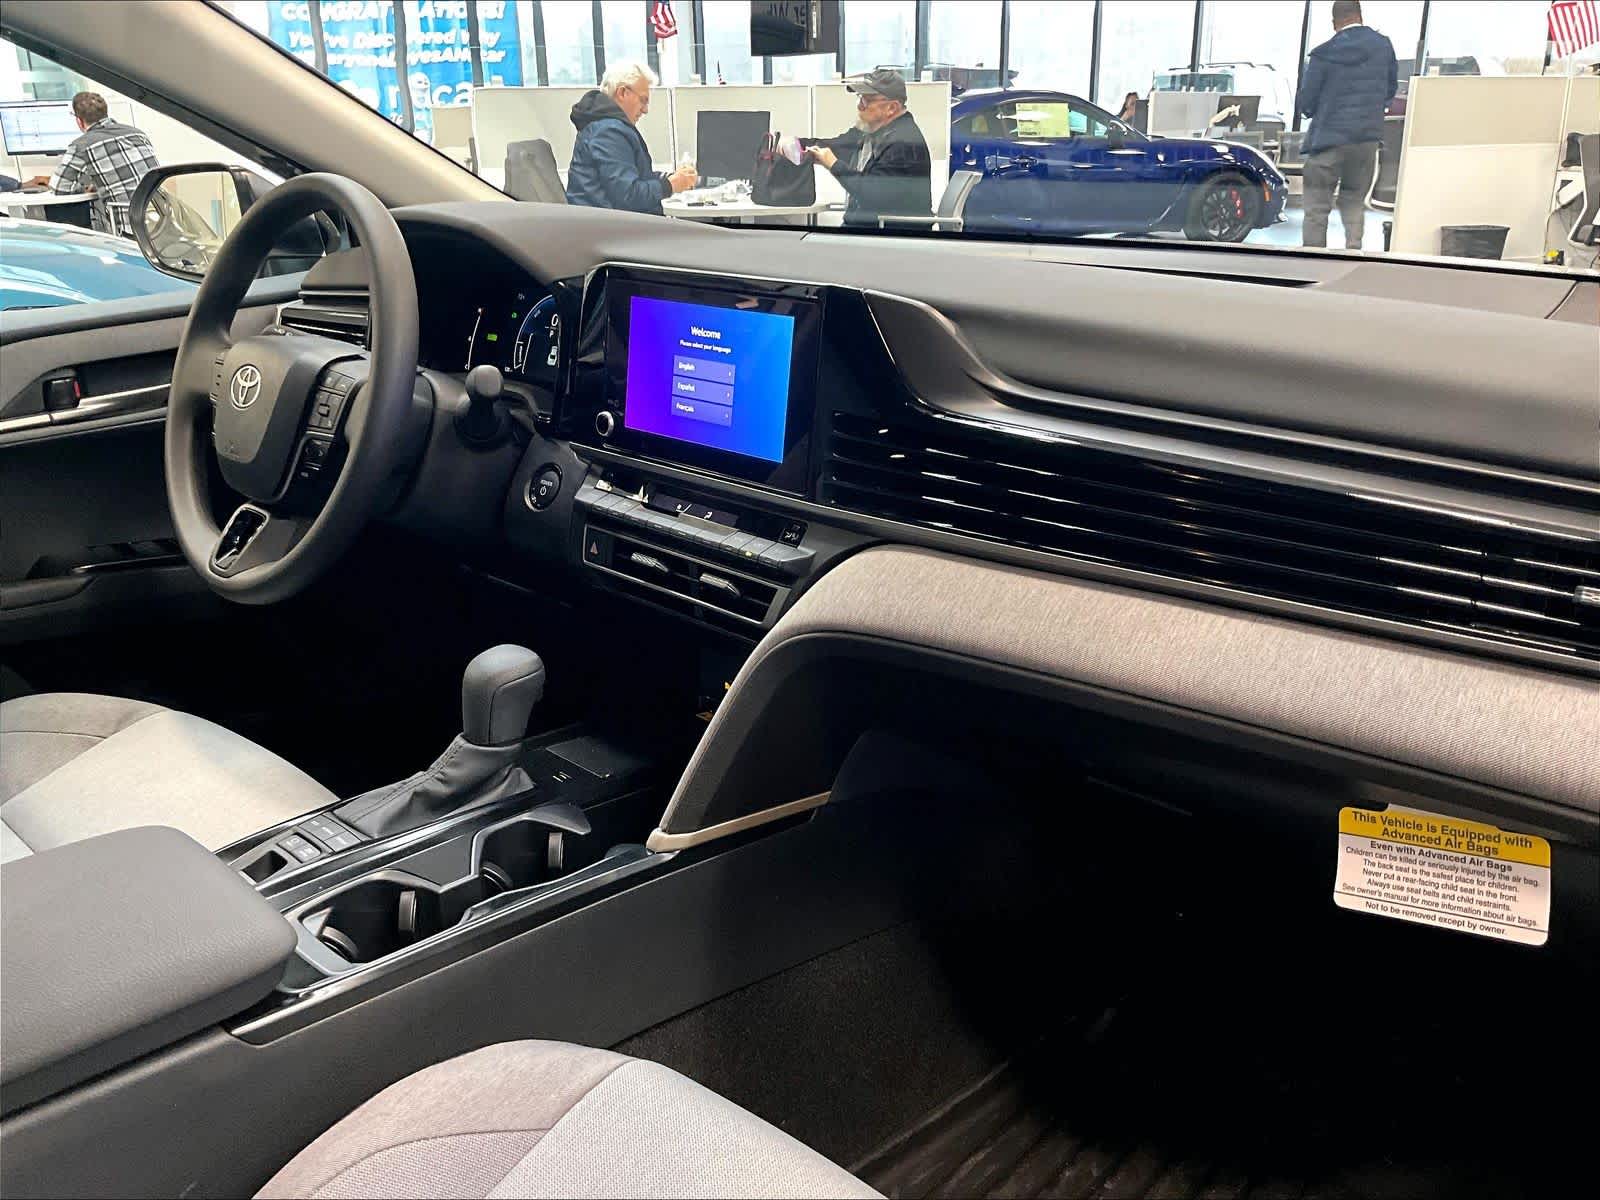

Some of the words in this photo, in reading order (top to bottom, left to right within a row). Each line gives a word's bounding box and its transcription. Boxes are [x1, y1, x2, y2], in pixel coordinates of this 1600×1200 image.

[691, 326, 721, 339] Welcome
[678, 361, 696, 371] English
[677, 382, 696, 392] Español
[676, 402, 695, 413] Français
[1351, 810, 1376, 824] This
[1379, 815, 1423, 831] Vehicle
[1426, 822, 1437, 833] is
[1440, 824, 1500, 845] Equipped
[1504, 835, 1533, 849] with
[1382, 826, 1441, 845] Advanced
[1444, 837, 1462, 849] Air
[1466, 840, 1498, 856] Bags
[1345, 846, 1373, 857] Children
[1399, 855, 1416, 865] killed
[1427, 860, 1458, 873] seriously
[1460, 866, 1485, 878] injured
[1487, 871, 1496, 880] by
[1498, 872, 1509, 881] the
[1511, 875, 1521, 883] air
[1370, 840, 1393, 851] Even
[1395, 844, 1415, 855] with
[1417, 848, 1466, 864] Advanced
[1469, 857, 1482, 866] Air
[1486, 859, 1512, 873] Bags
[1362, 868, 1381, 878] Never
[1383, 872, 1394, 881] put
[1402, 875, 1440, 889] rear-facing
[1441, 882, 1457, 891] child
[1459, 886, 1474, 894] seat
[1477, 888, 1484, 896] in
[1485, 890, 1497, 898] the
[1363, 858, 1375, 867] The
[1377, 861, 1393, 870] back
[1395, 864, 1409, 873] seat
[1419, 868, 1430, 876] the
[1432, 870, 1453, 880] safest
[1454, 875, 1474, 885] place
[1476, 878, 1486, 886] for
[1342, 882, 1355, 891] See
[1356, 886, 1382, 897] owner's
[1383, 891, 1408, 902] manual
[1410, 895, 1419, 904] for
[1421, 899, 1439, 907] more
[1441, 901, 1481, 915] information
[1483, 909, 1504, 920] about
[1505, 914, 1516, 922] air
[1367, 878, 1390, 890] Always
[1406, 886, 1420, 894] seat
[1422, 888, 1439, 897] belts
[1441, 892, 1455, 901] and
[1456, 894, 1473, 904] child
[1365, 901, 1379, 910] Not
[1390, 905, 1400, 914] be
[1401, 908, 1436, 921] removed
[1438, 915, 1465, 927] except
[1467, 920, 1477, 930] by
